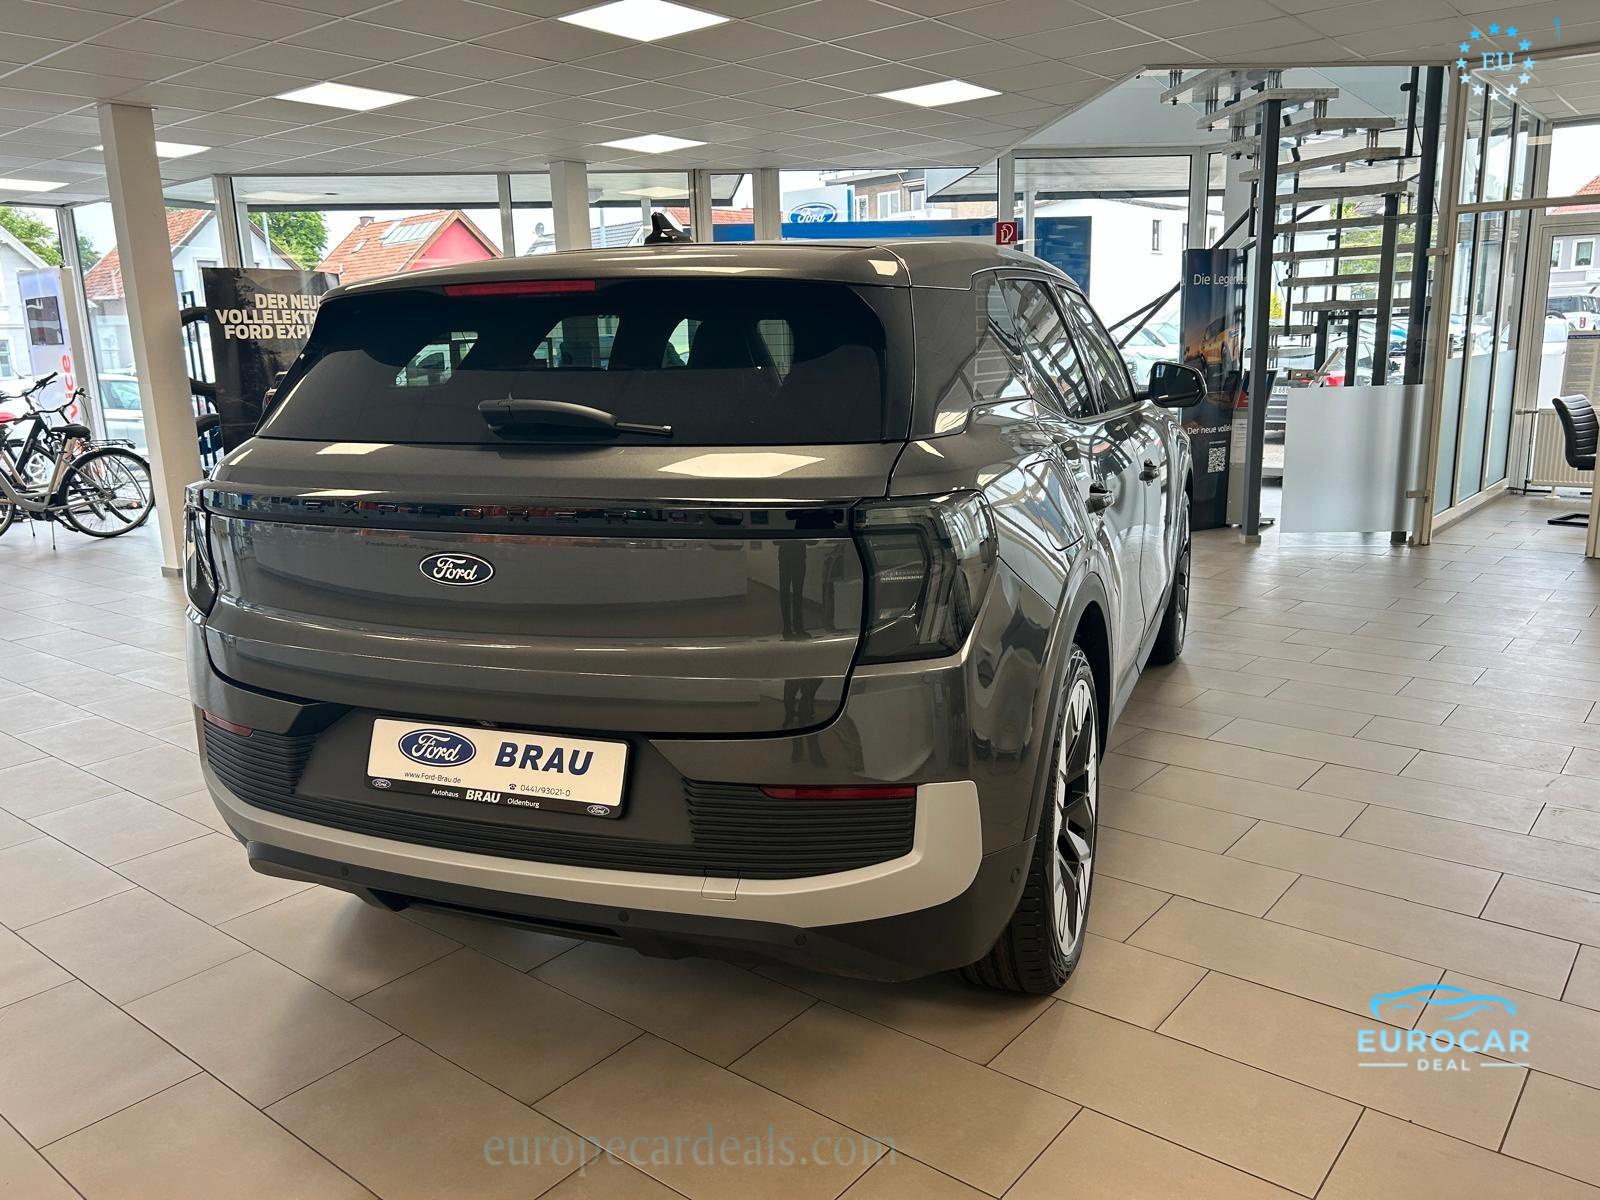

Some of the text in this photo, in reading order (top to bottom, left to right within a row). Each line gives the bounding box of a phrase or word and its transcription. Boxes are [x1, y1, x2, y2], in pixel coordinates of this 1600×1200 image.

[797, 207, 826, 222] Ford
[1193, 273, 1211, 286] Die
[254, 293, 289, 309] DER
[224, 324, 274, 340] FORD
[1201, 426, 1217, 434] neue
[433, 557, 478, 581] Ford
[411, 733, 594, 776] Ford BRAU
[404, 771, 462, 784] www.Ford-Brau.de
[431, 788, 541, 809] Autohaus BRAU Oldenburg
[520, 784, 571, 798] 0441/93021-0
